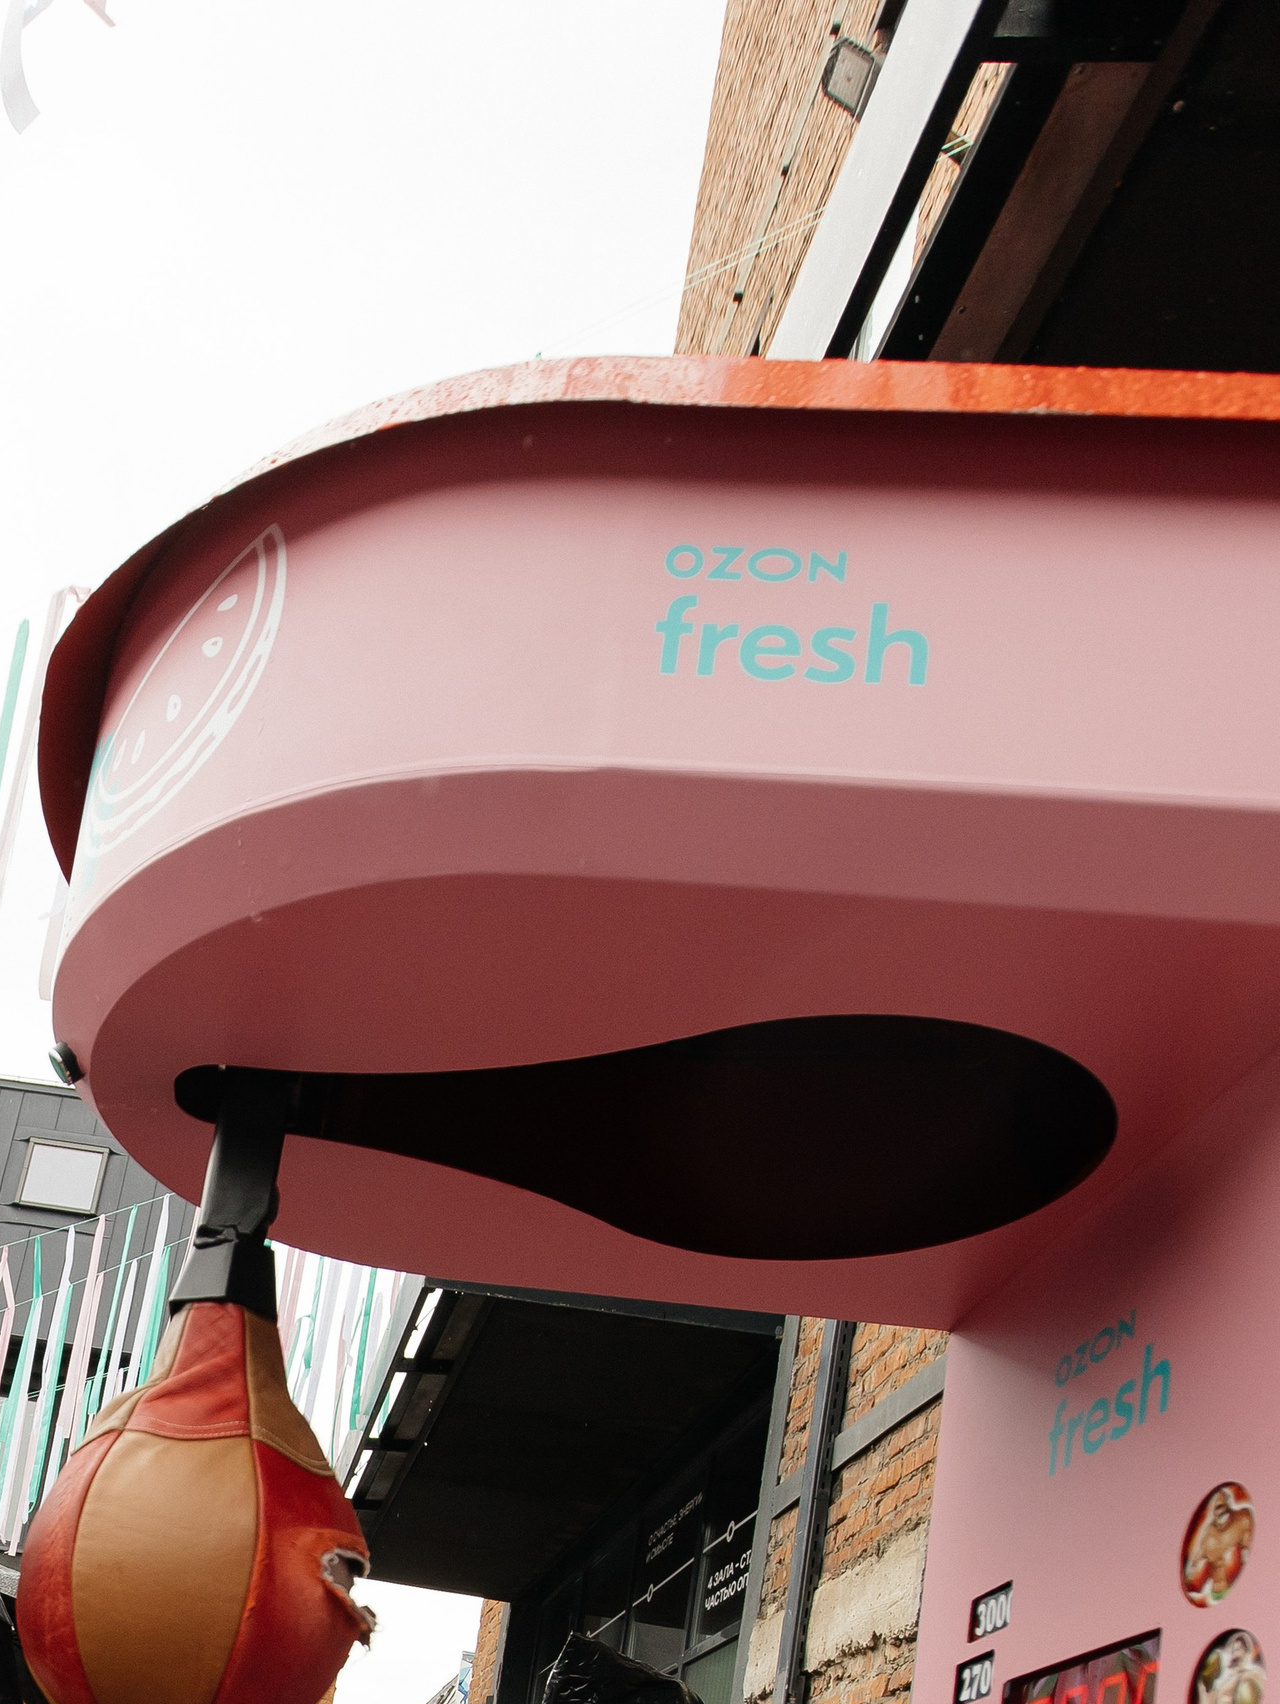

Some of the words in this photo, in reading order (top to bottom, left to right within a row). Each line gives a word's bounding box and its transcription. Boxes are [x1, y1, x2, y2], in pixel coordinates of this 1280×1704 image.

[664, 543, 848, 583] OZON
[655, 594, 929, 686] fresh
[1055, 1309, 1137, 1388] OZON
[1048, 1343, 1171, 1477] fresh
[713, 1562, 735, 1586] ЗАЛА
[740, 1549, 752, 1569] СТ
[704, 1580, 737, 1610] ЧАСТЬЮ
[959, 1660, 992, 1702] 270
